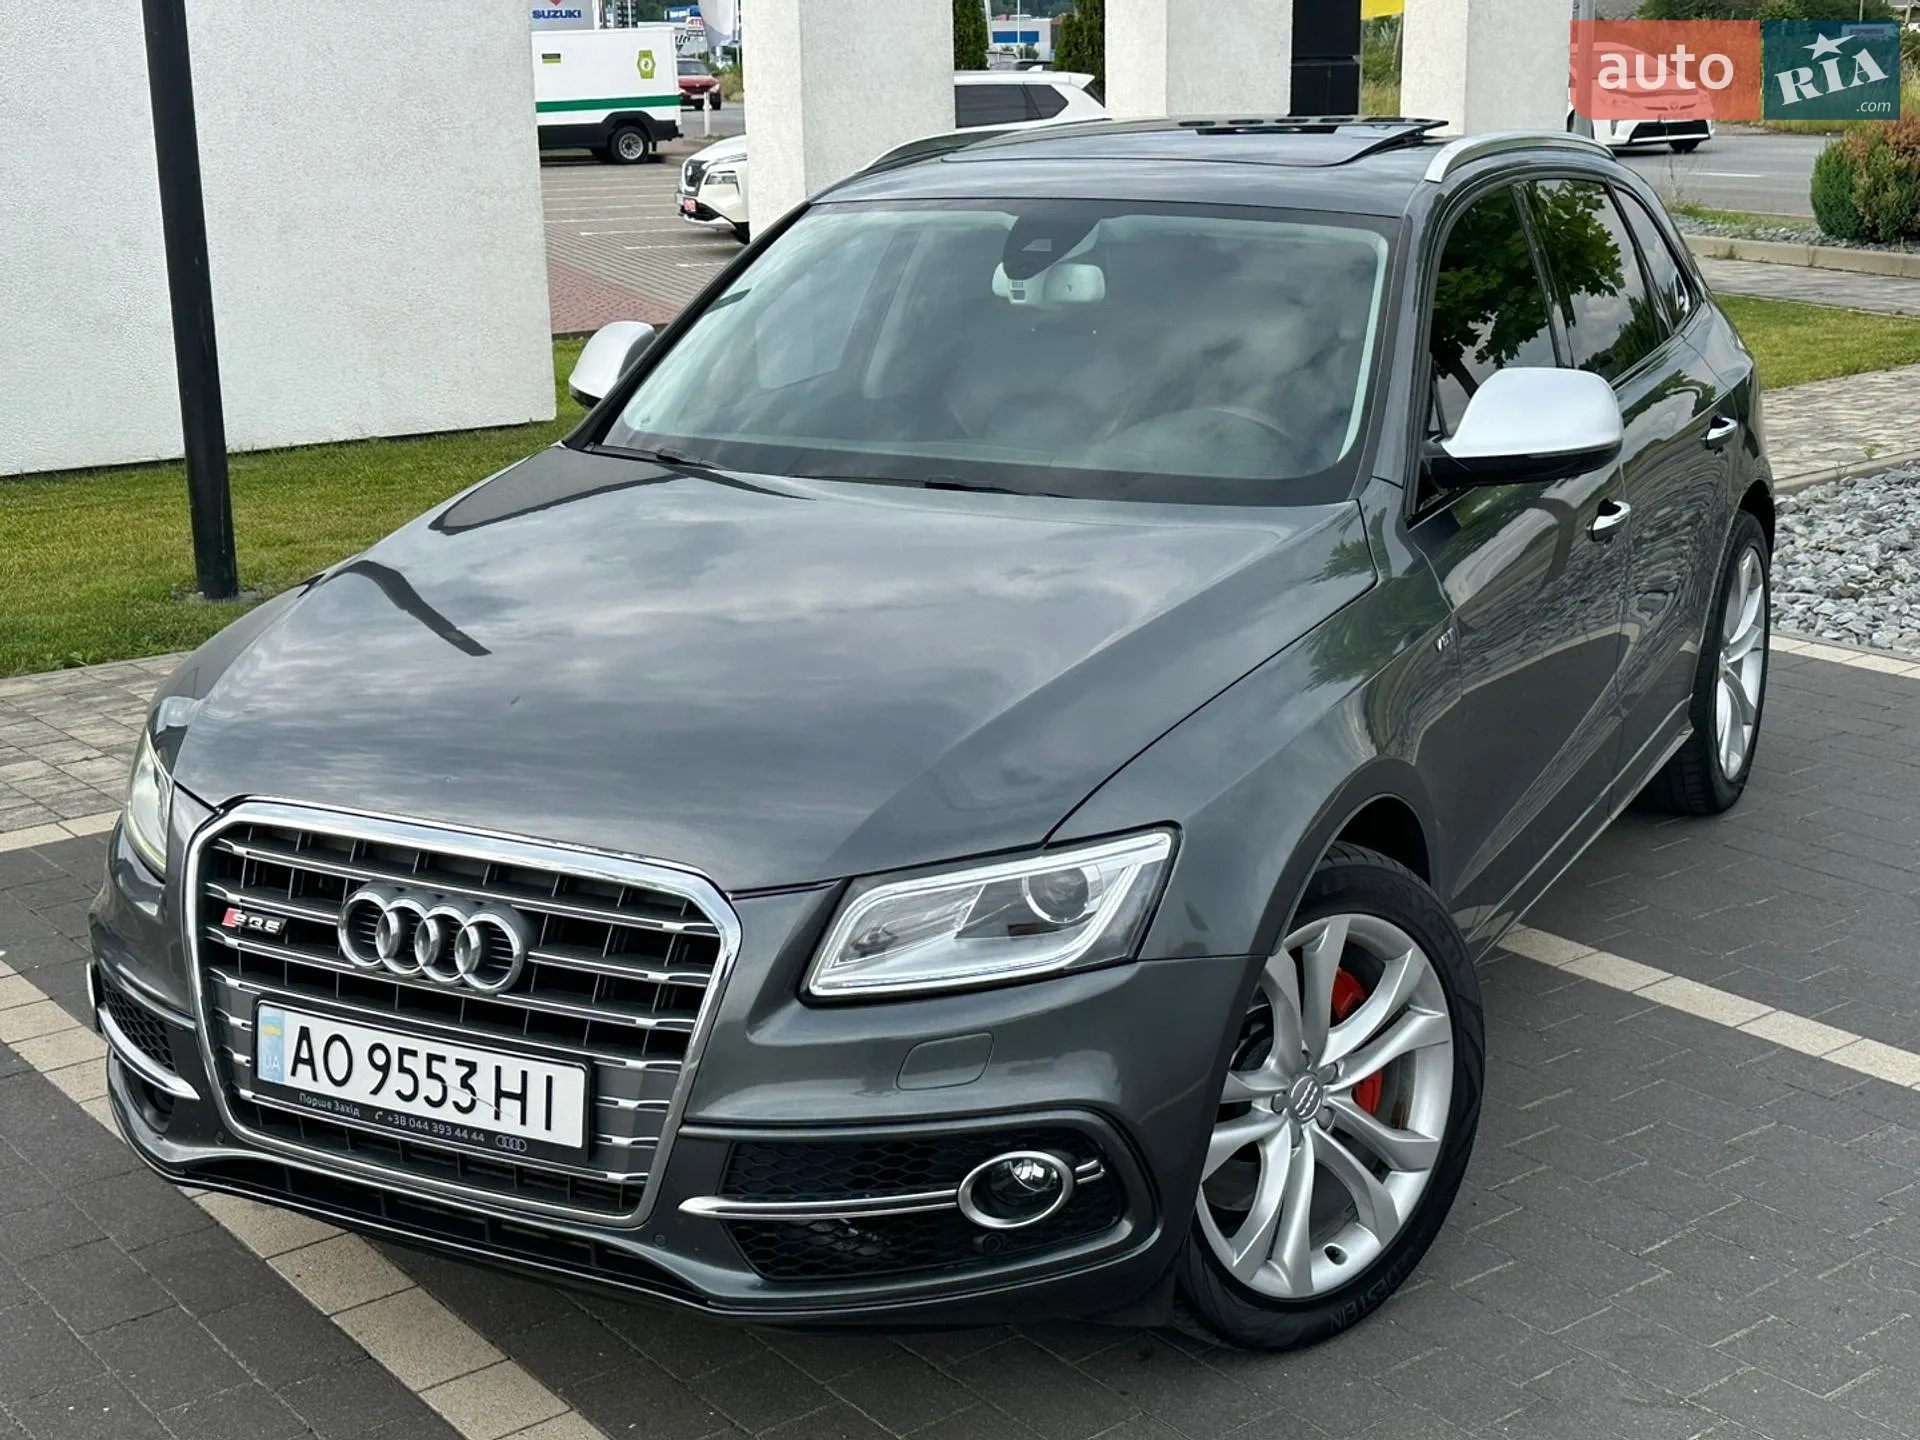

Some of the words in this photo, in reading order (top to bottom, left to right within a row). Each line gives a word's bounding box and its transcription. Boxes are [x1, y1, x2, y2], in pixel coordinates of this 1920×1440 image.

[532, 9, 582, 19] SUZUKI
[265, 1055, 281, 1070] UA
[290, 1025, 353, 1088] AO
[368, 1042, 478, 1115] 9553
[494, 1065, 553, 1131] HI
[299, 1092, 333, 1111] Порше
[387, 1113, 407, 1126] +38
[409, 1117, 429, 1131] 044
[432, 1123, 452, 1136] 393
[454, 1128, 469, 1140] 44
[471, 1131, 485, 1143] 44
